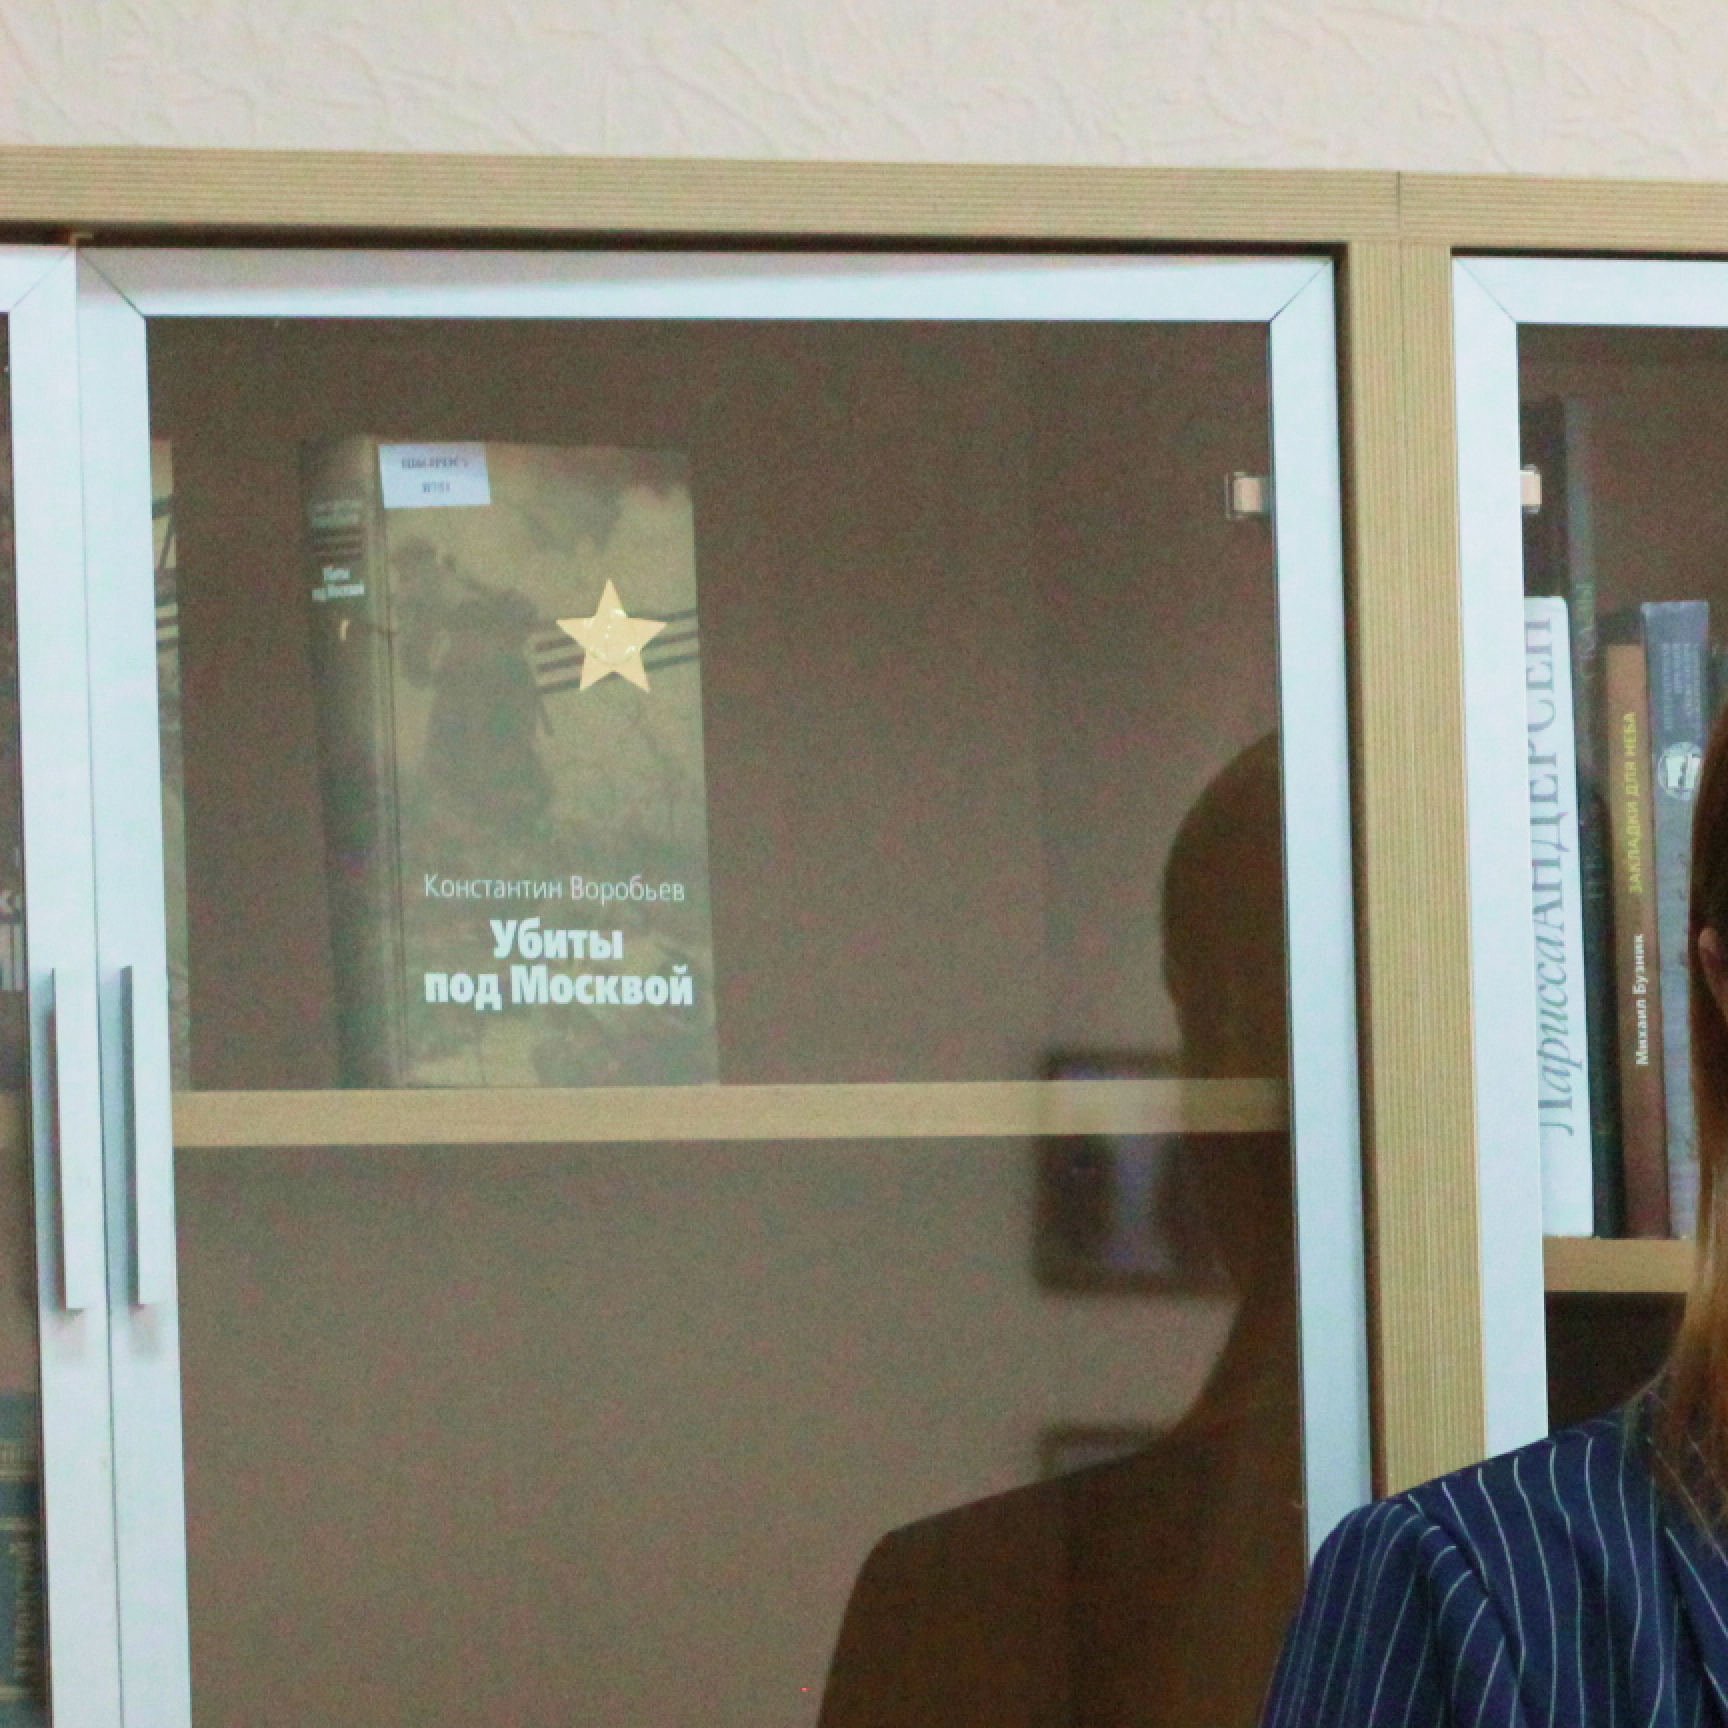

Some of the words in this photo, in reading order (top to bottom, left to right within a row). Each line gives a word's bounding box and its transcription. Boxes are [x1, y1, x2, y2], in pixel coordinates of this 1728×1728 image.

[1623, 711, 1637, 757] НЕБА
[1524, 619, 1570, 933] АНДЕРСЕН
[1624, 762, 1639, 797] ДЛЯ
[1625, 801, 1643, 893] ЗАКЛАДКИ
[424, 873, 563, 899] Константин
[570, 873, 685, 906] Воробьев
[490, 916, 623, 960] Убиты
[424, 972, 503, 1011] под
[510, 964, 693, 1006] Москвой
[1632, 933, 1648, 995] Бузник
[1635, 998, 1649, 1066] Михаил
